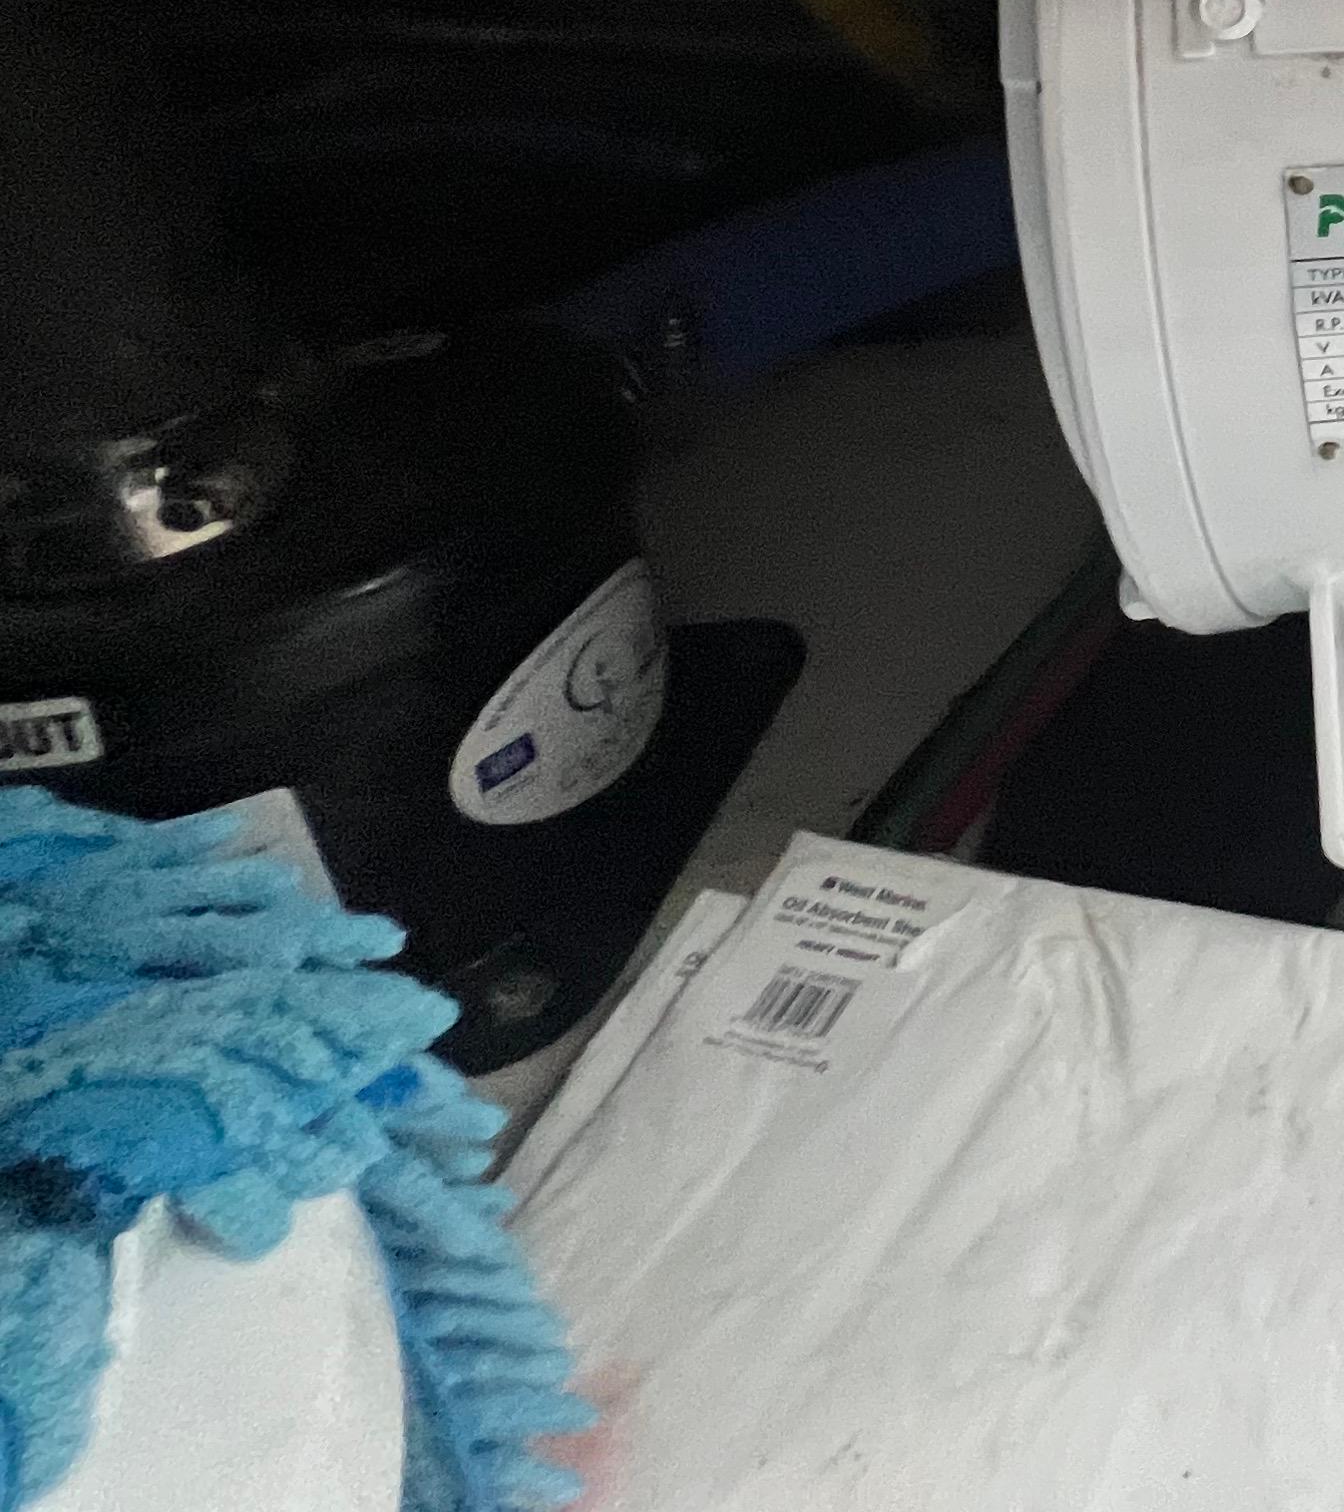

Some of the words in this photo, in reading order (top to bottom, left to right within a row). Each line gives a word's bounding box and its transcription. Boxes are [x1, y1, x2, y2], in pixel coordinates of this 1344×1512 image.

[1316, 341, 1330, 354] V
[1320, 363, 1334, 377] A
[782, 896, 807, 913] Oil
[807, 901, 890, 930] Absorbent
